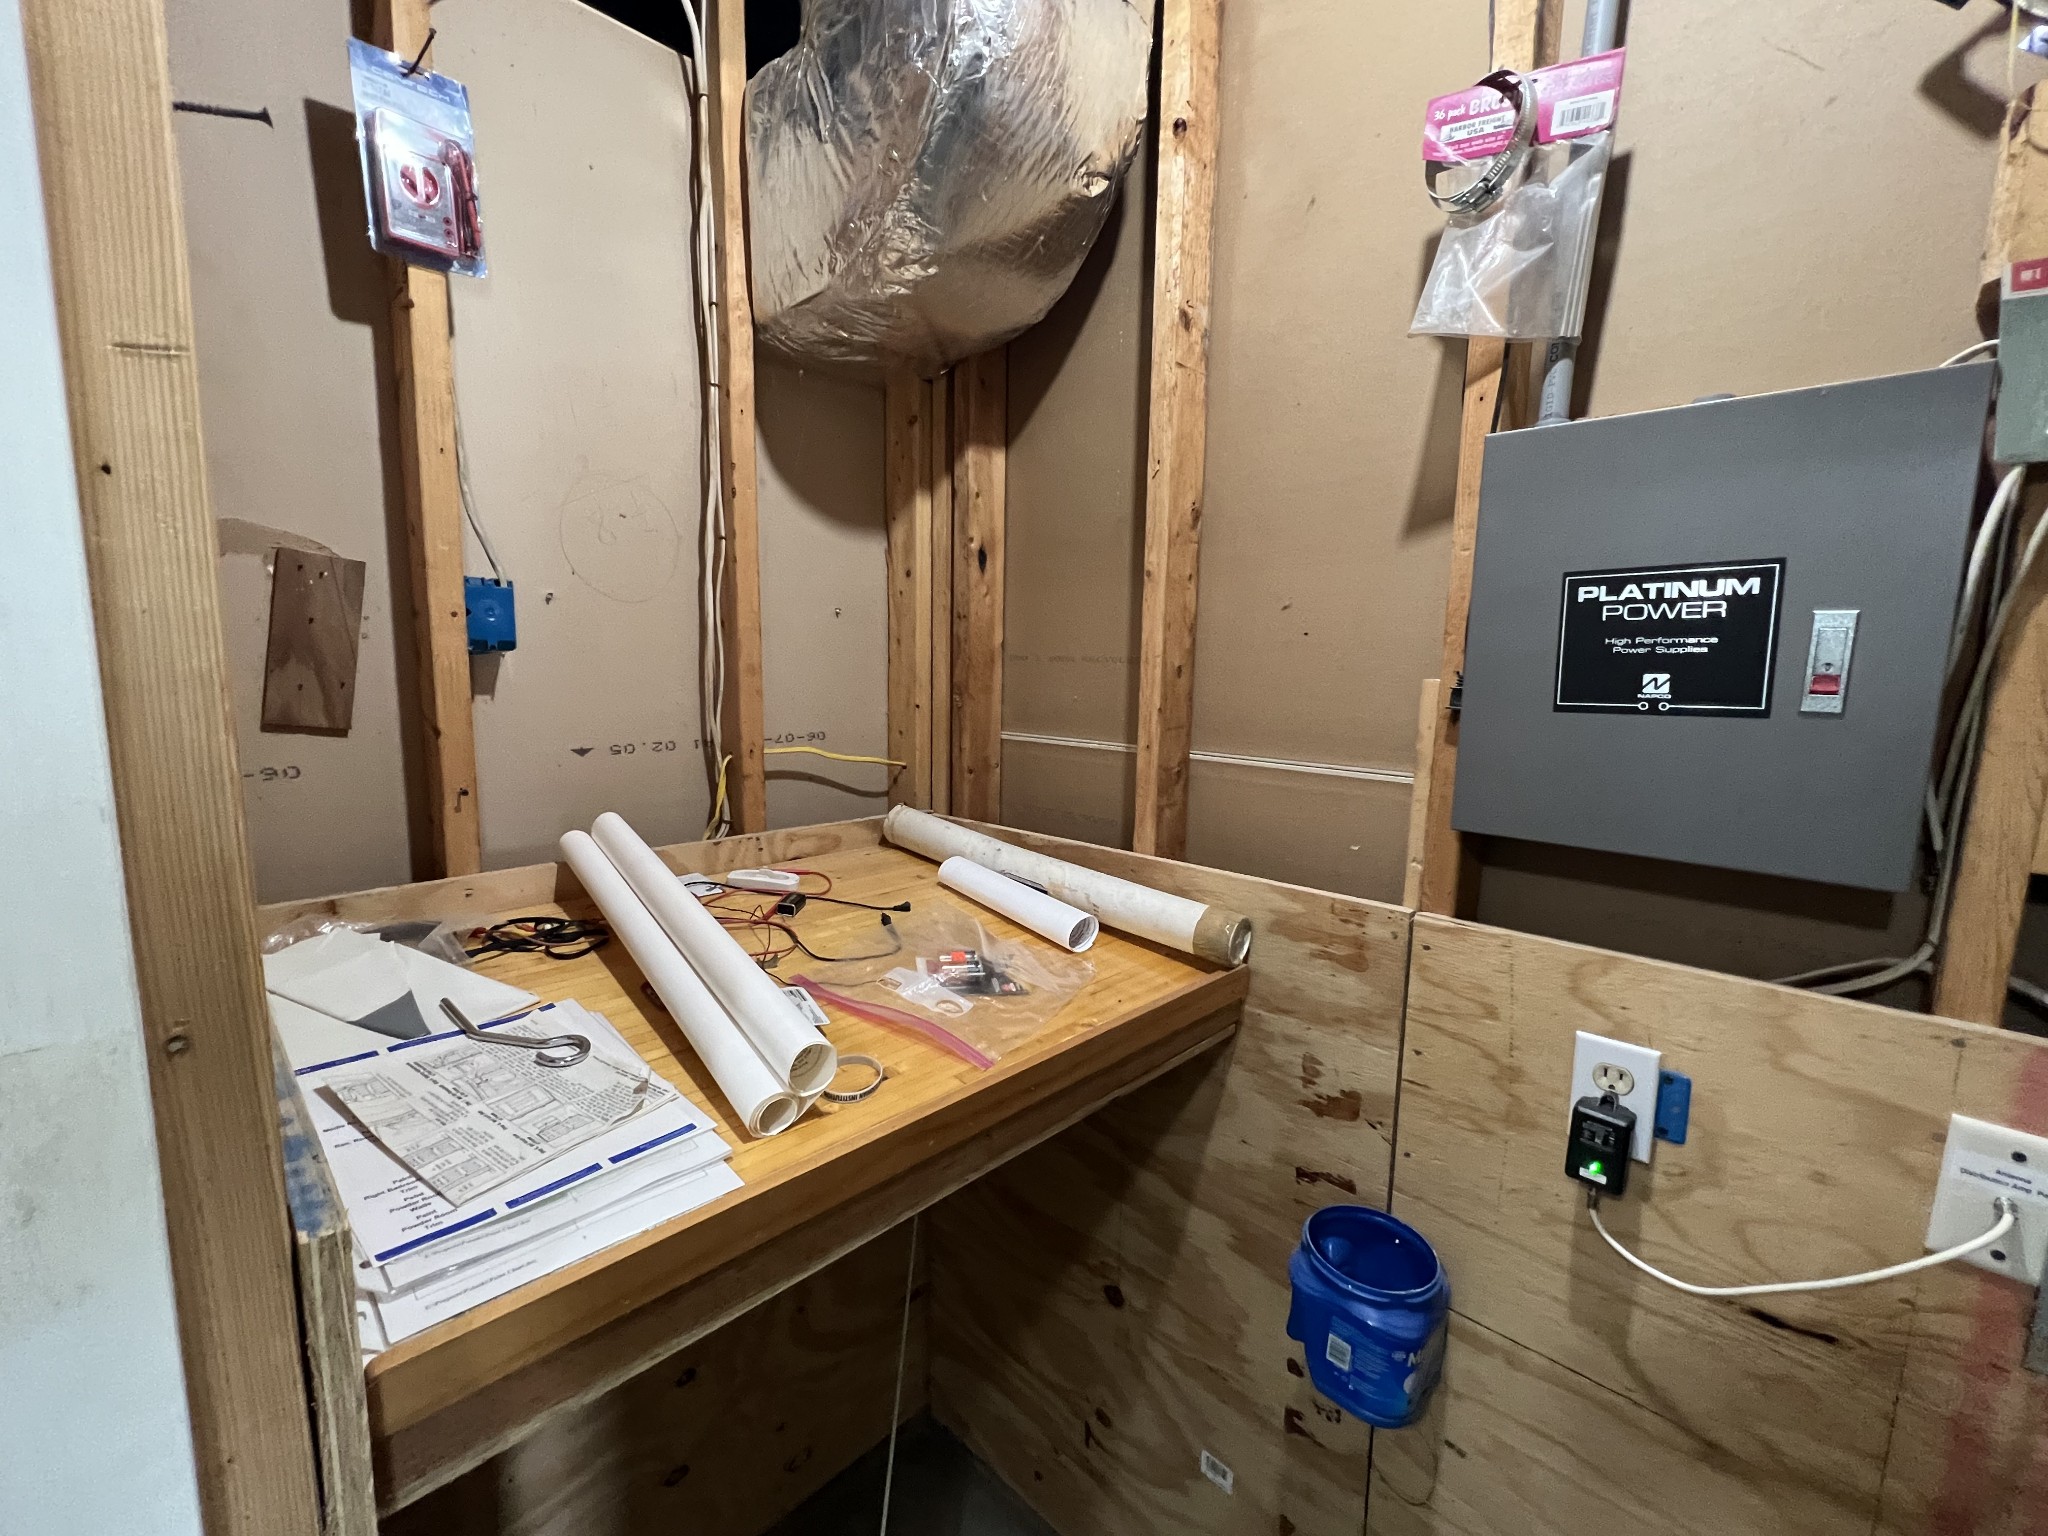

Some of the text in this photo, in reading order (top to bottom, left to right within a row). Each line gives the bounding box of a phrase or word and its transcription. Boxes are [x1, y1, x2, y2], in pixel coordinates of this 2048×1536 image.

[1434, 108, 1446, 120] 36
[1447, 103, 1466, 121] pack
[1449, 121, 1476, 133] HARBOR
[1467, 127, 1484, 136] USA
[1577, 577, 1761, 602] PLATINUM
[1602, 600, 1727, 621] POWER
[1605, 636, 1719, 647] High Performance
[1612, 645, 1709, 654] Power Supplies
